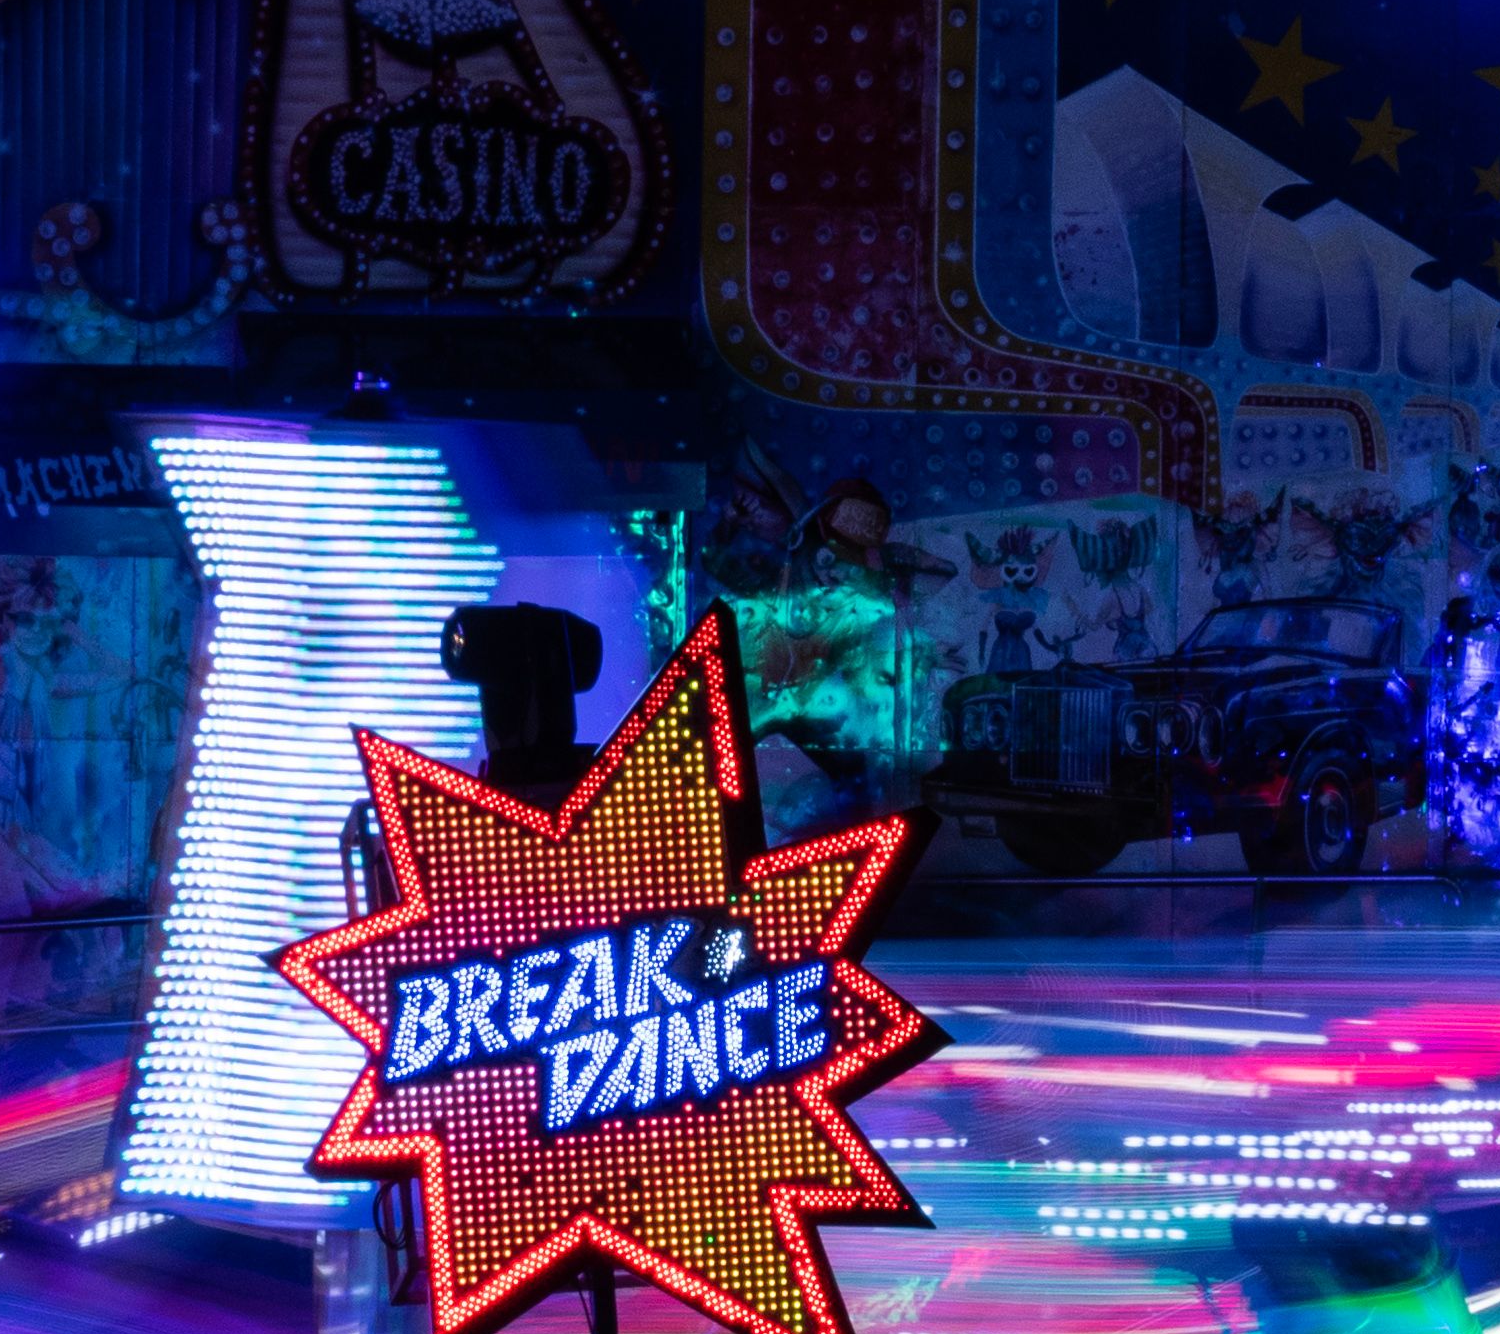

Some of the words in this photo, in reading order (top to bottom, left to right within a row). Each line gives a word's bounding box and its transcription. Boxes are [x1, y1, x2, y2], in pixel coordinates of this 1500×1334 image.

[327, 122, 592, 227] CASINO
[383, 919, 694, 1083] BREAK
[541, 961, 829, 1134] DANCE
